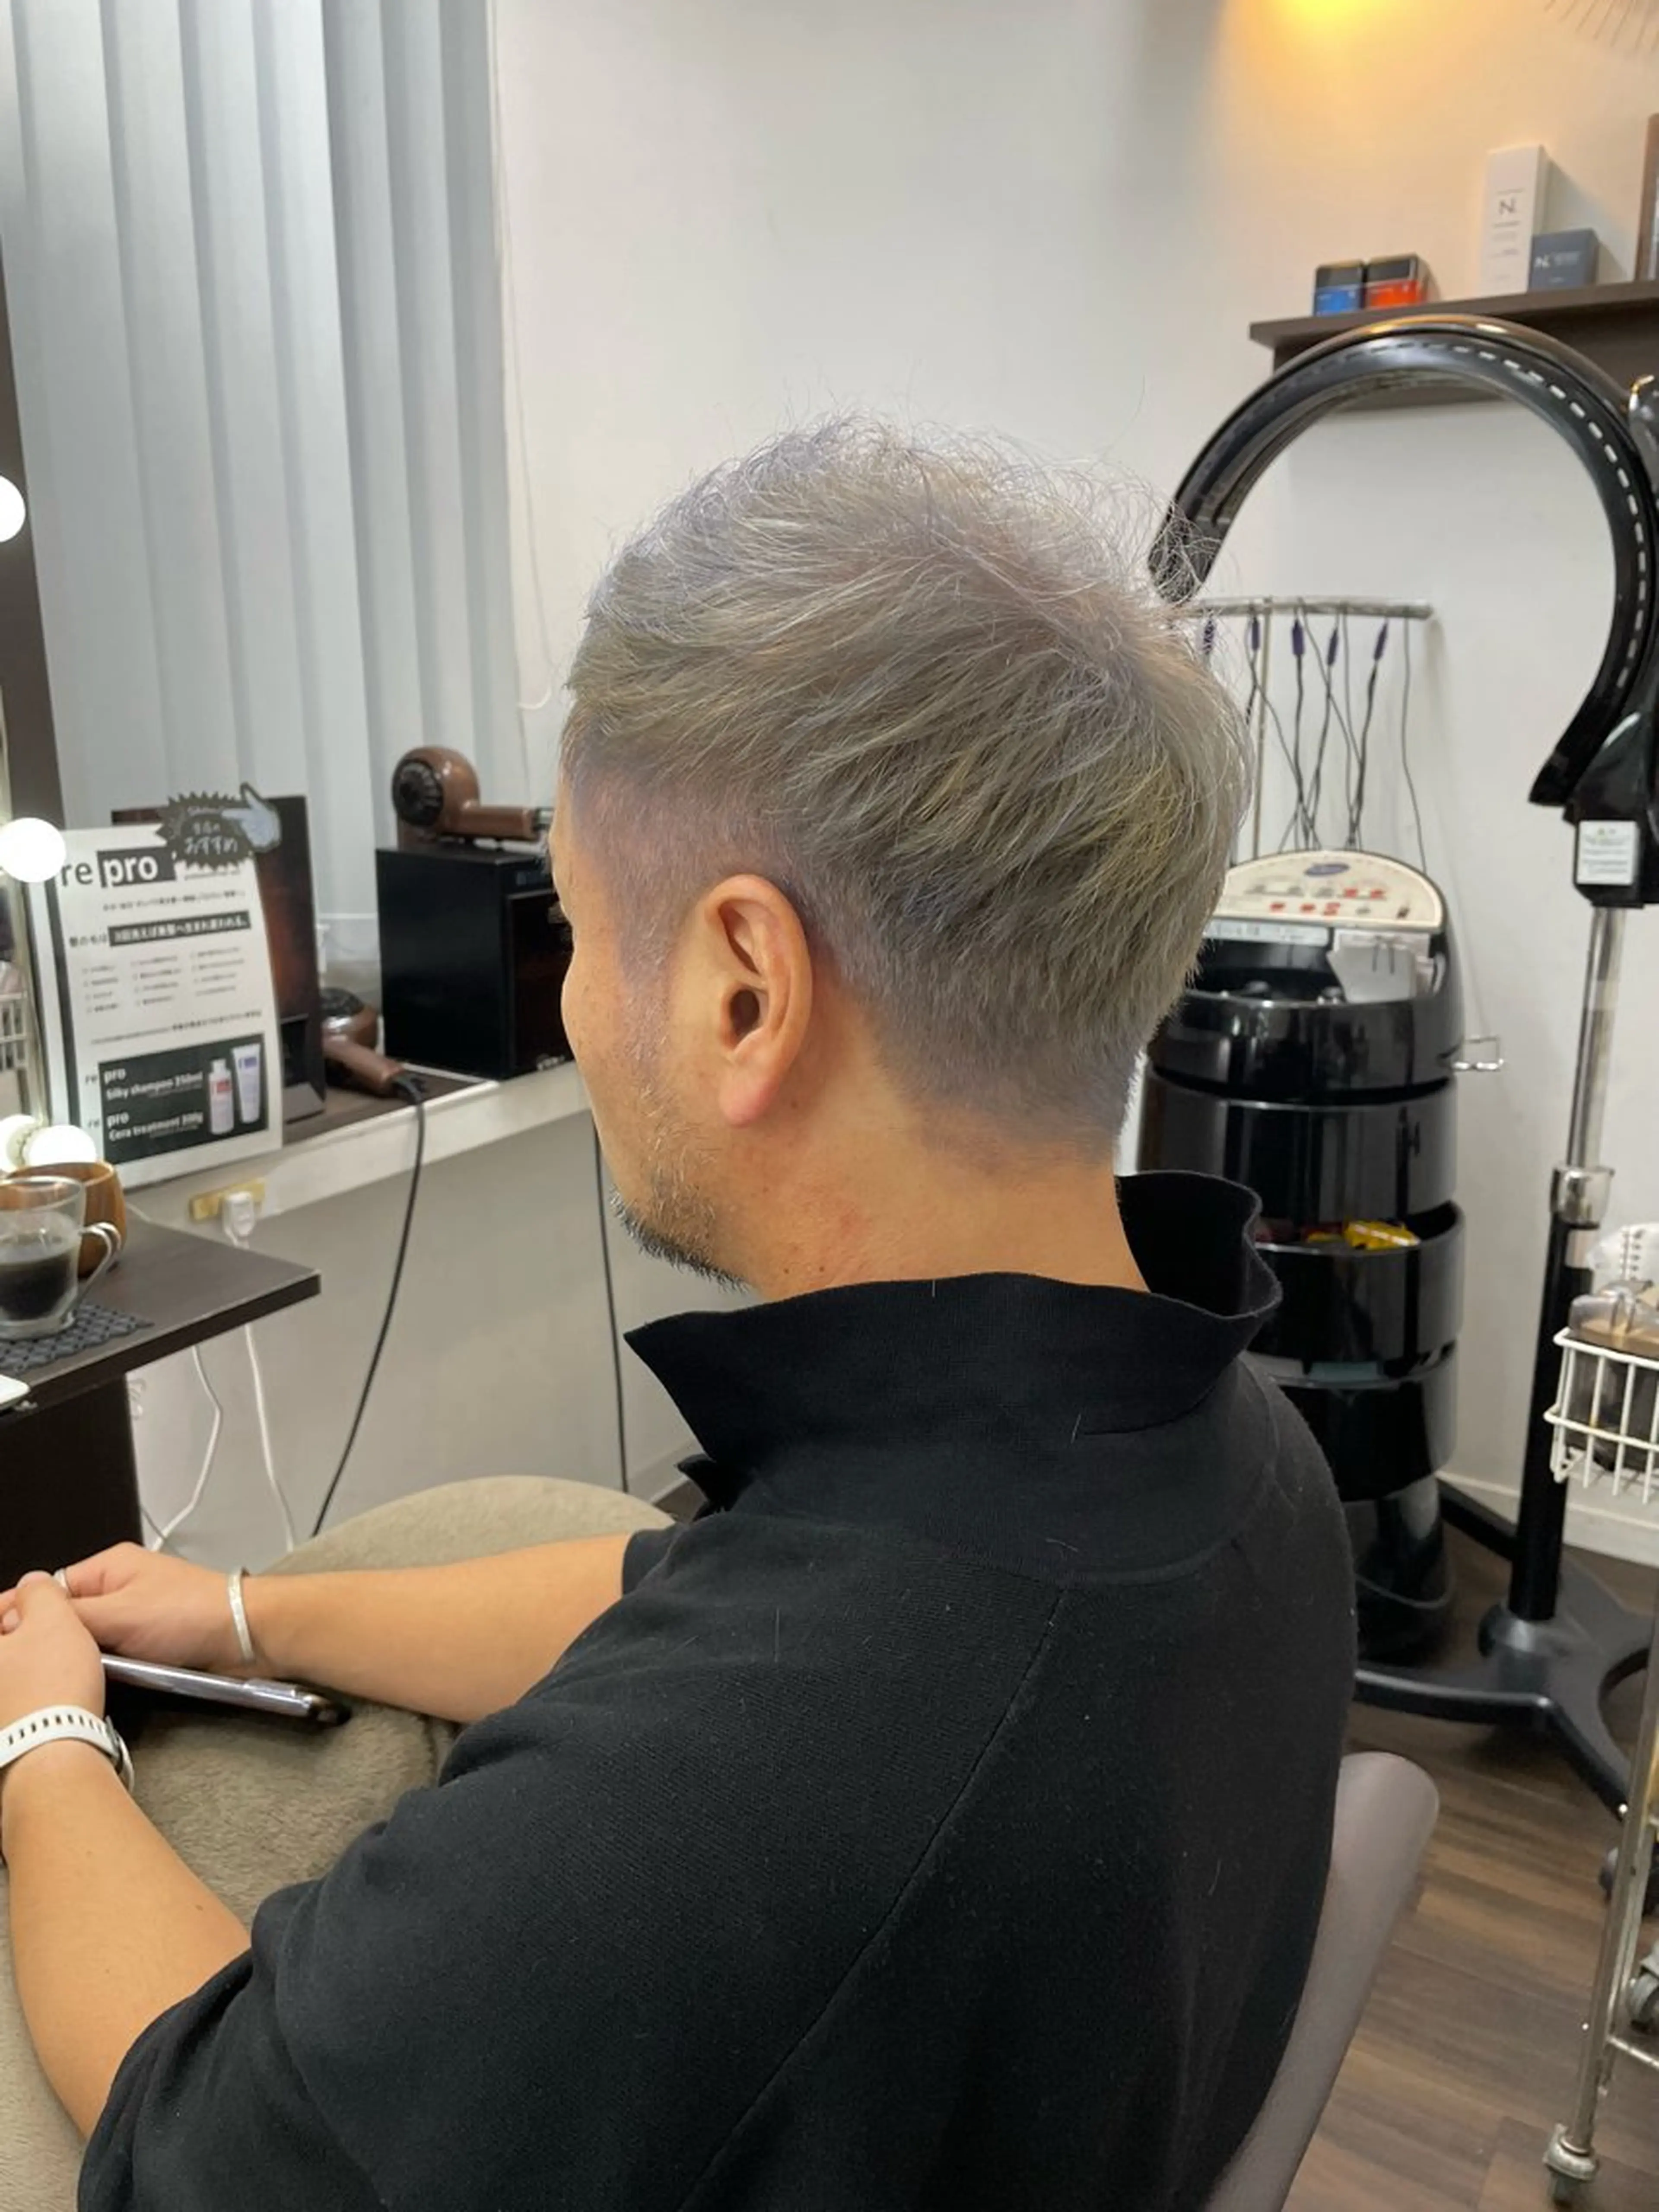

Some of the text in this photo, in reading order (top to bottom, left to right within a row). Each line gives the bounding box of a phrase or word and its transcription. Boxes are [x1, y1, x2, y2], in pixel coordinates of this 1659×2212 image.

[185, 836, 238, 855] おすすめ
[62, 863, 92, 886] re
[103, 856, 158, 888] pro
[104, 1068, 126, 1085] pro
[107, 1112, 129, 1129] pro
